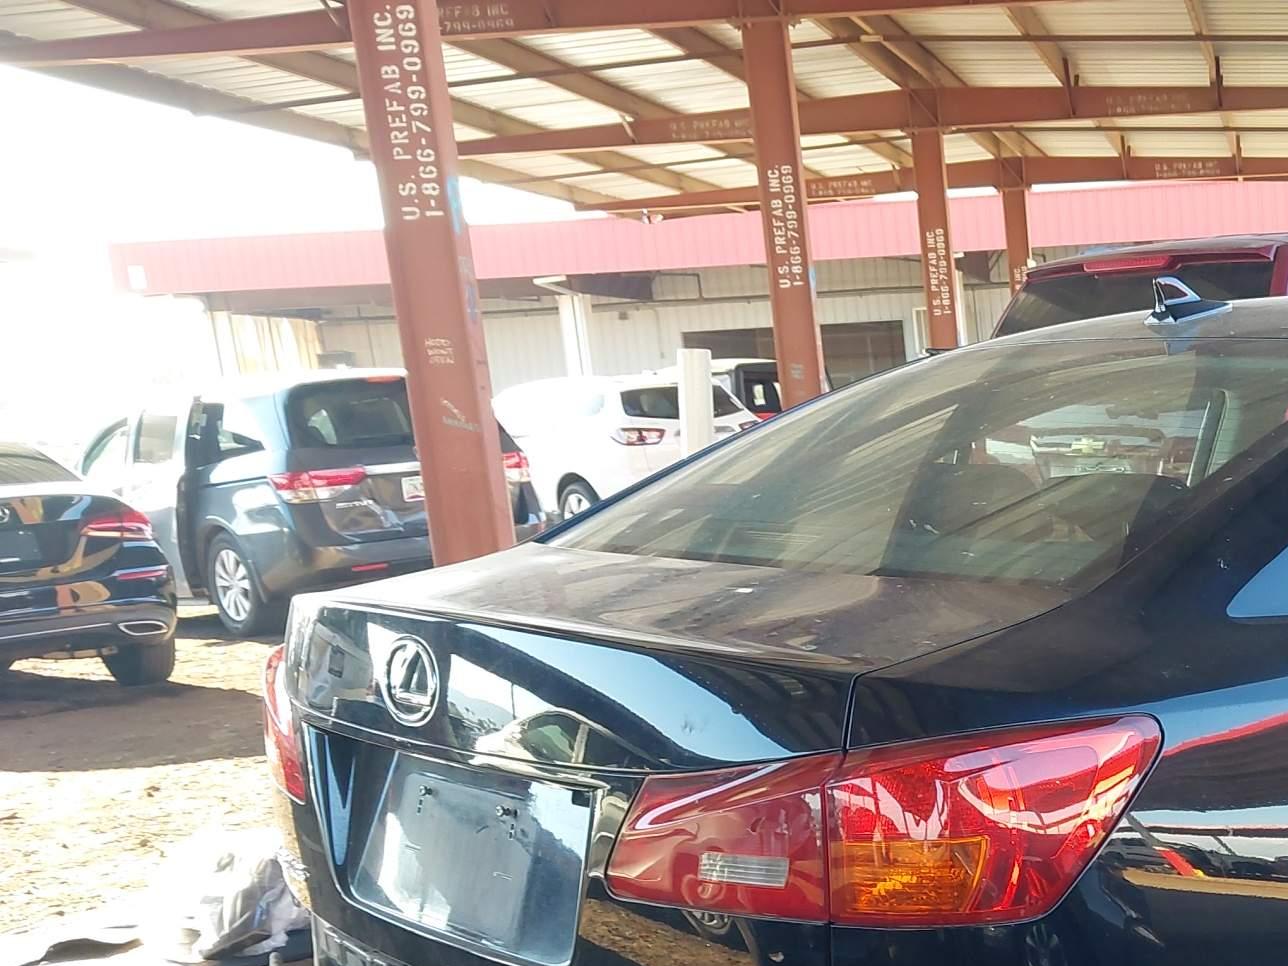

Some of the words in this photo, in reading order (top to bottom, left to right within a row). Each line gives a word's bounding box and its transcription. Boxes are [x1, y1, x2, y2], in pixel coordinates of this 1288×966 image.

[373, 4, 397, 51] INC.
[380, 64, 412, 160] PREFAB
[396, 4, 444, 217] 1-866-799-0969
[398, 175, 420, 220] U.S.
[767, 165, 781, 193] INC.
[770, 199, 788, 254] PREFAB
[780, 165, 804, 286] 1-866-799-0969
[778, 260, 791, 288] U.S.
